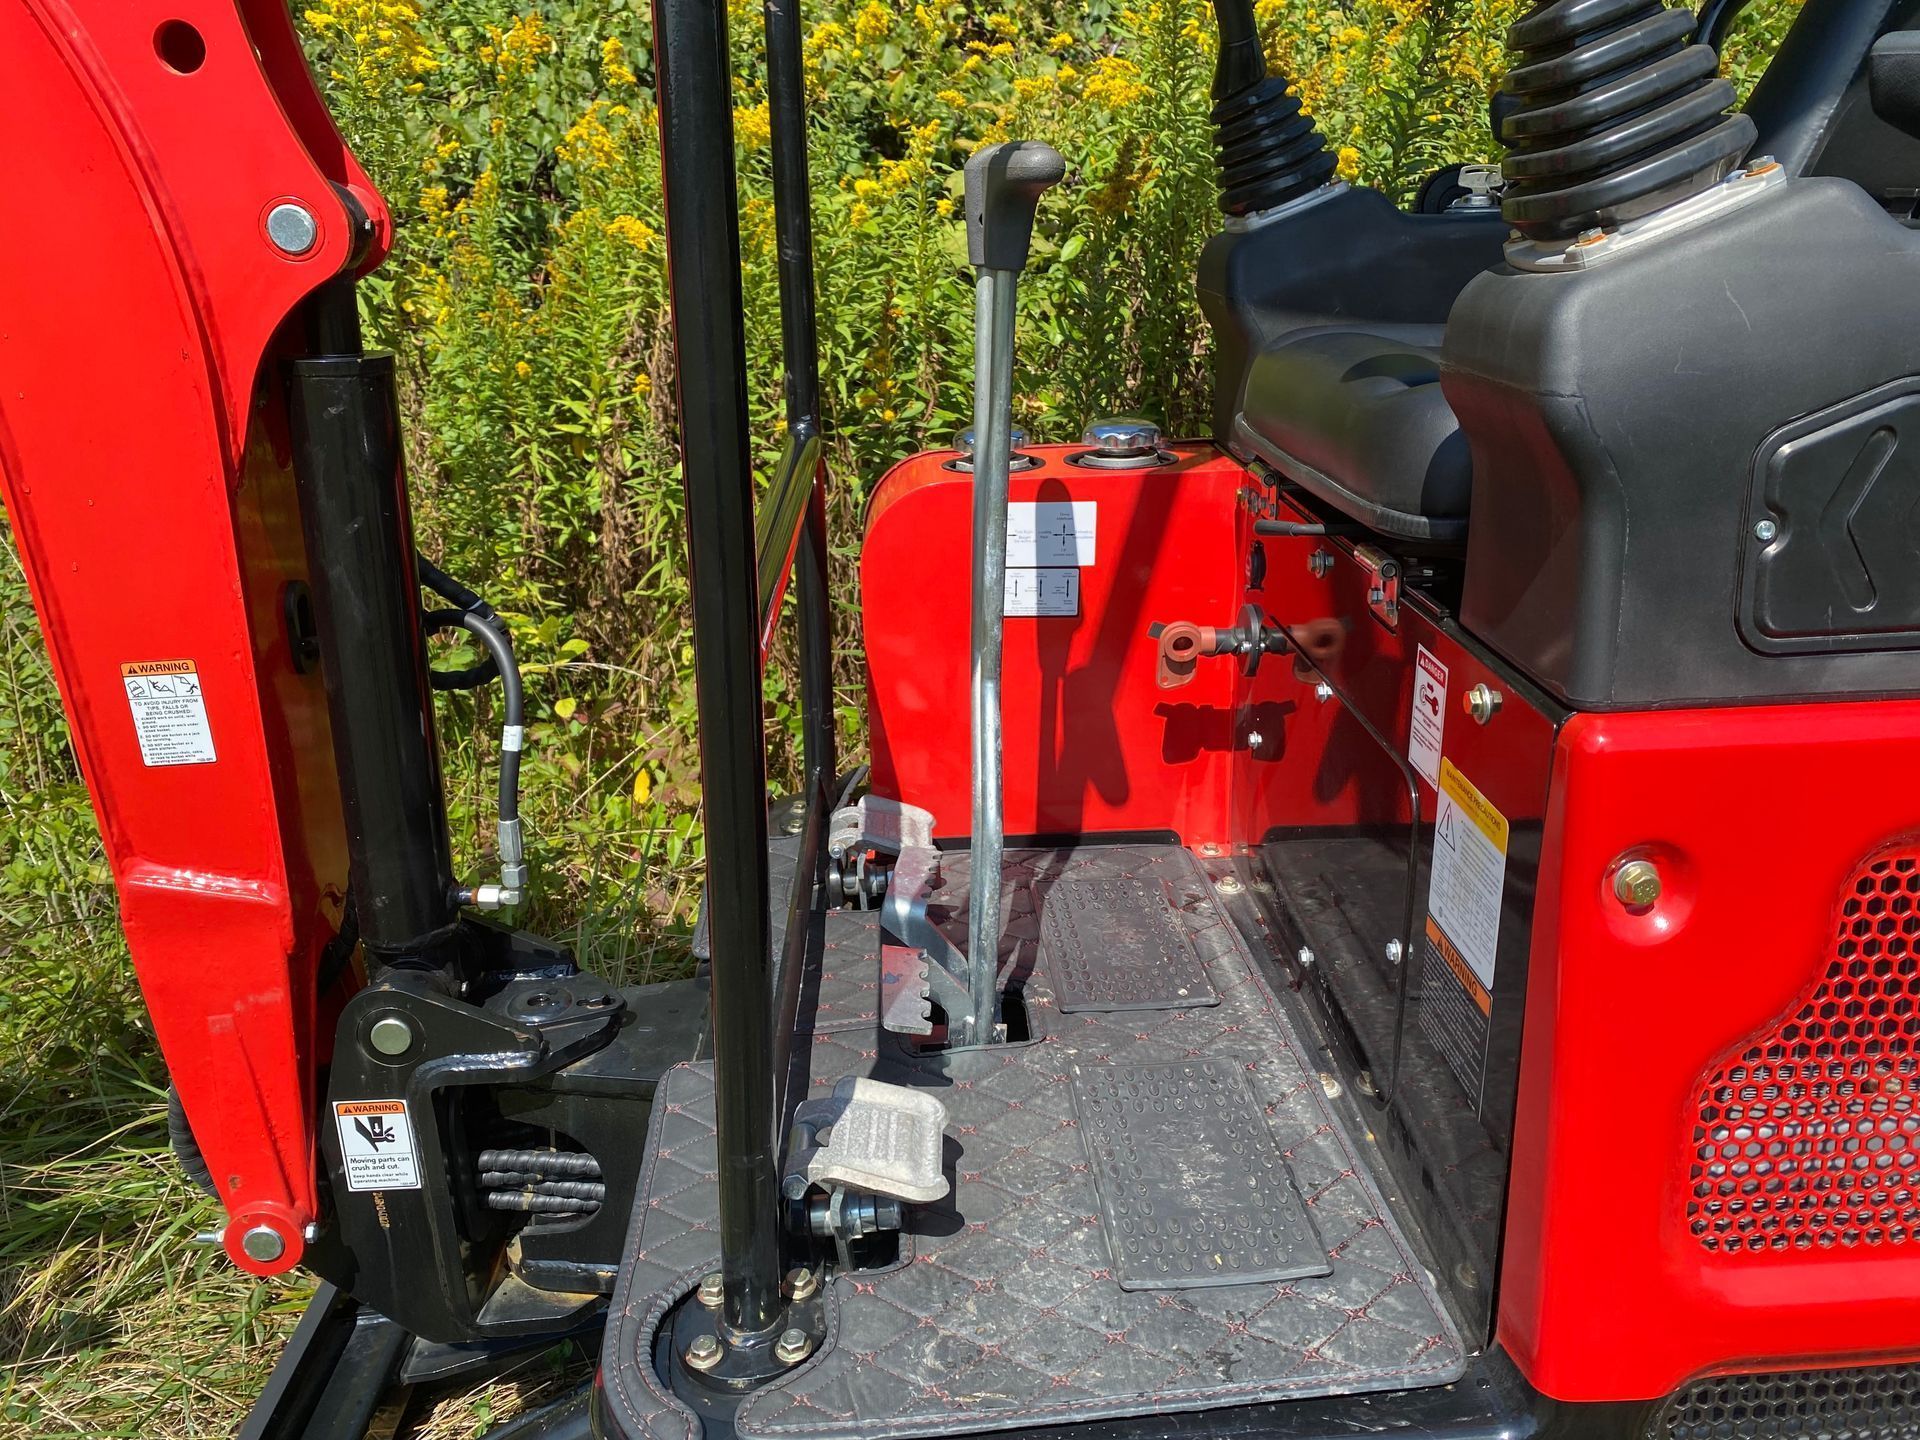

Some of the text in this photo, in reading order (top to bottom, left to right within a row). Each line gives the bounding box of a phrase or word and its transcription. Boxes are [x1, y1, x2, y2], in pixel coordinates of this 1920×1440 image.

[139, 662, 189, 673] WARNING
[1425, 659, 1444, 682] DANGER
[1444, 945, 1478, 996] WARNING
[353, 1104, 398, 1112] WARNING
